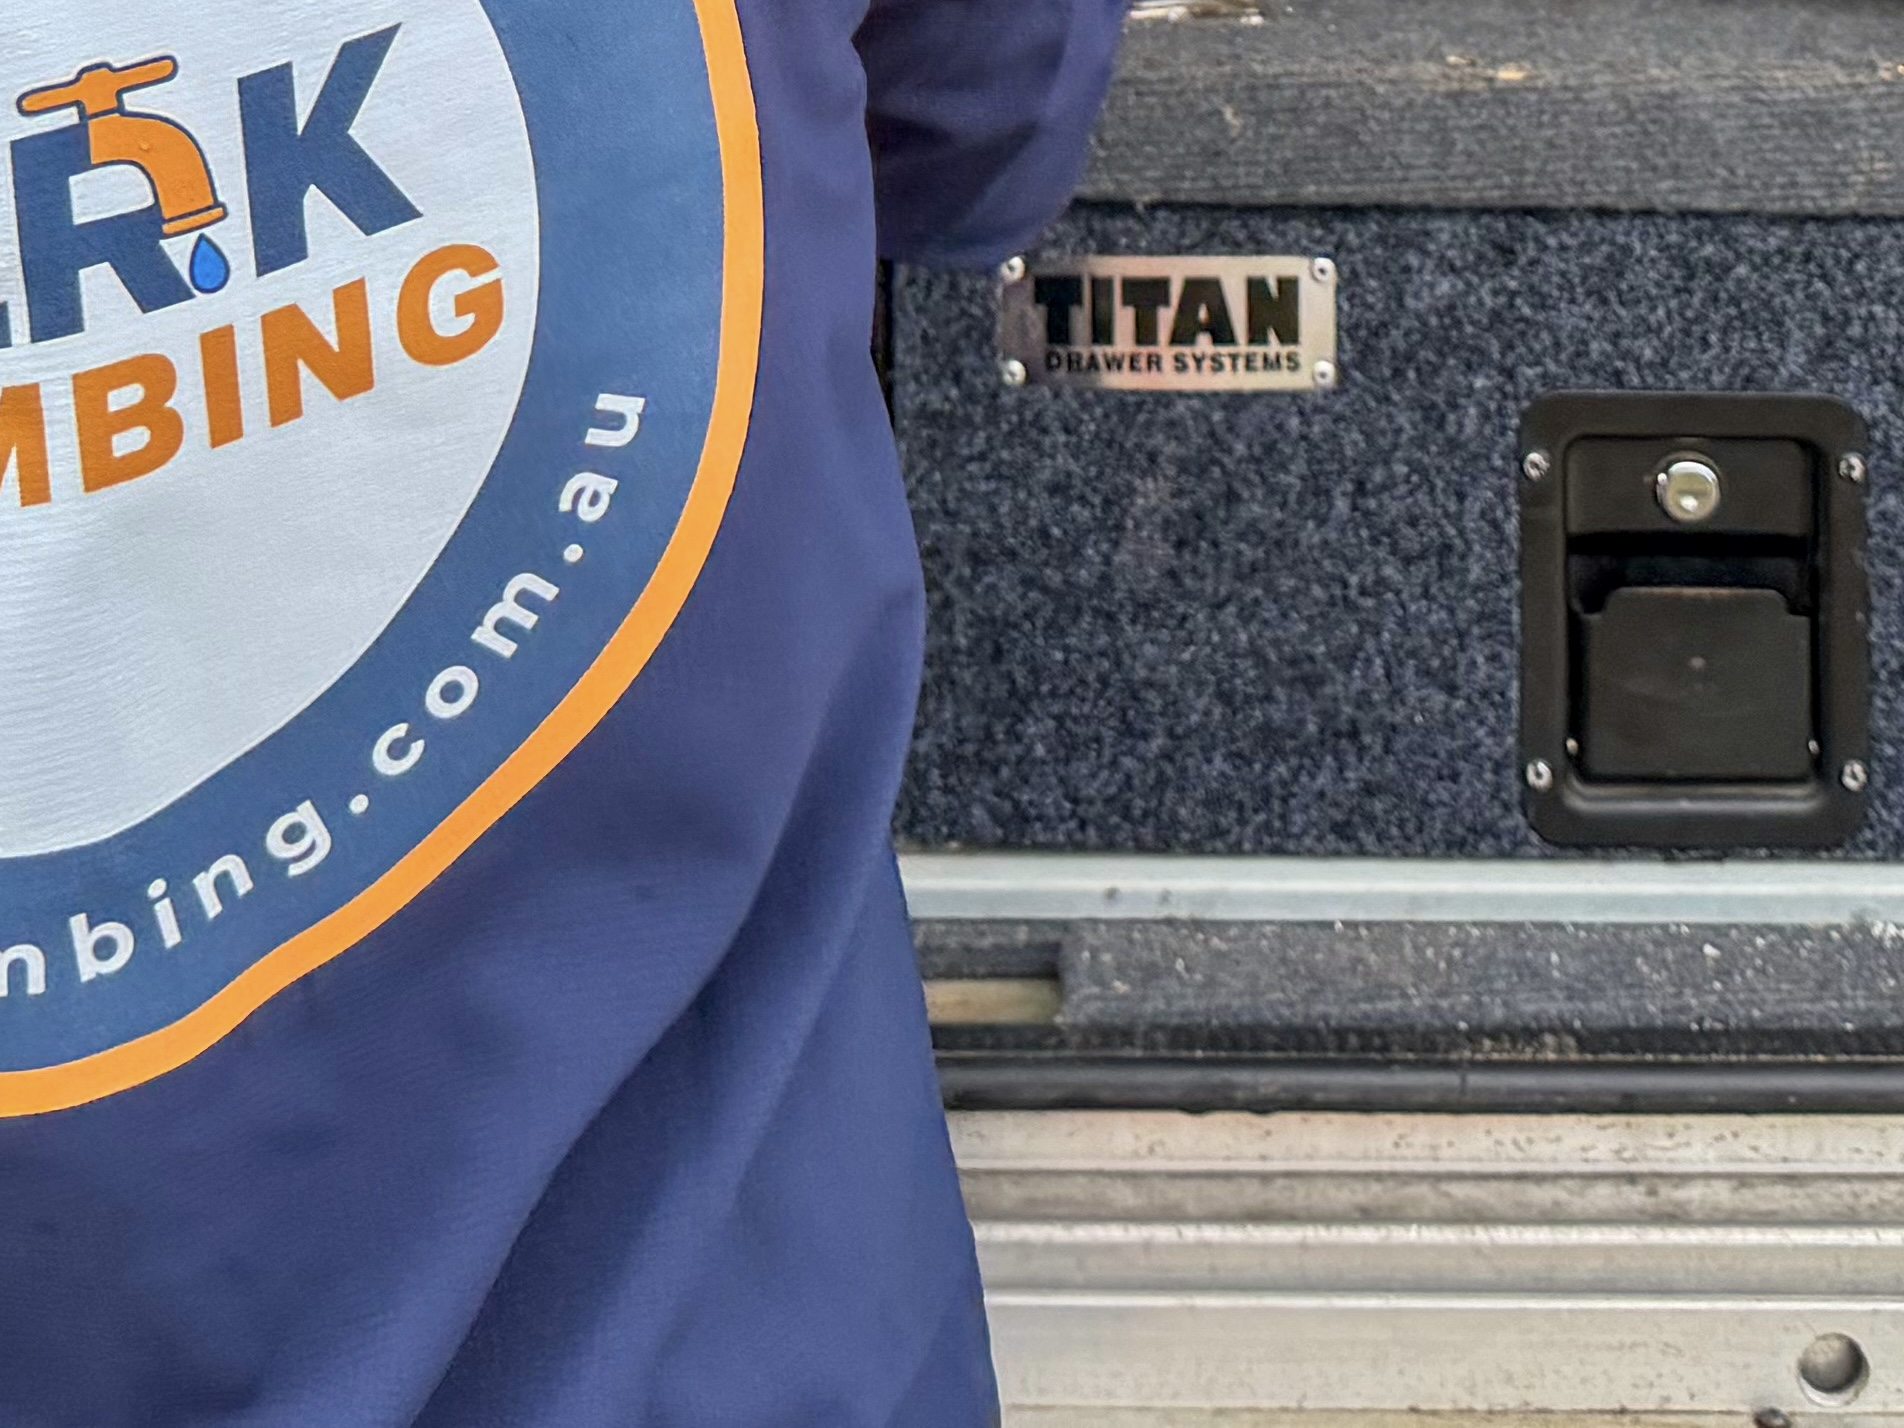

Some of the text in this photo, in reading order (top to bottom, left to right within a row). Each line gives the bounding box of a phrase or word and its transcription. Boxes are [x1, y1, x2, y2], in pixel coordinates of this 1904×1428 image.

[1034, 275, 1300, 346] TITAN
[1046, 350, 1302, 373] DRAWER SYSTEMS
